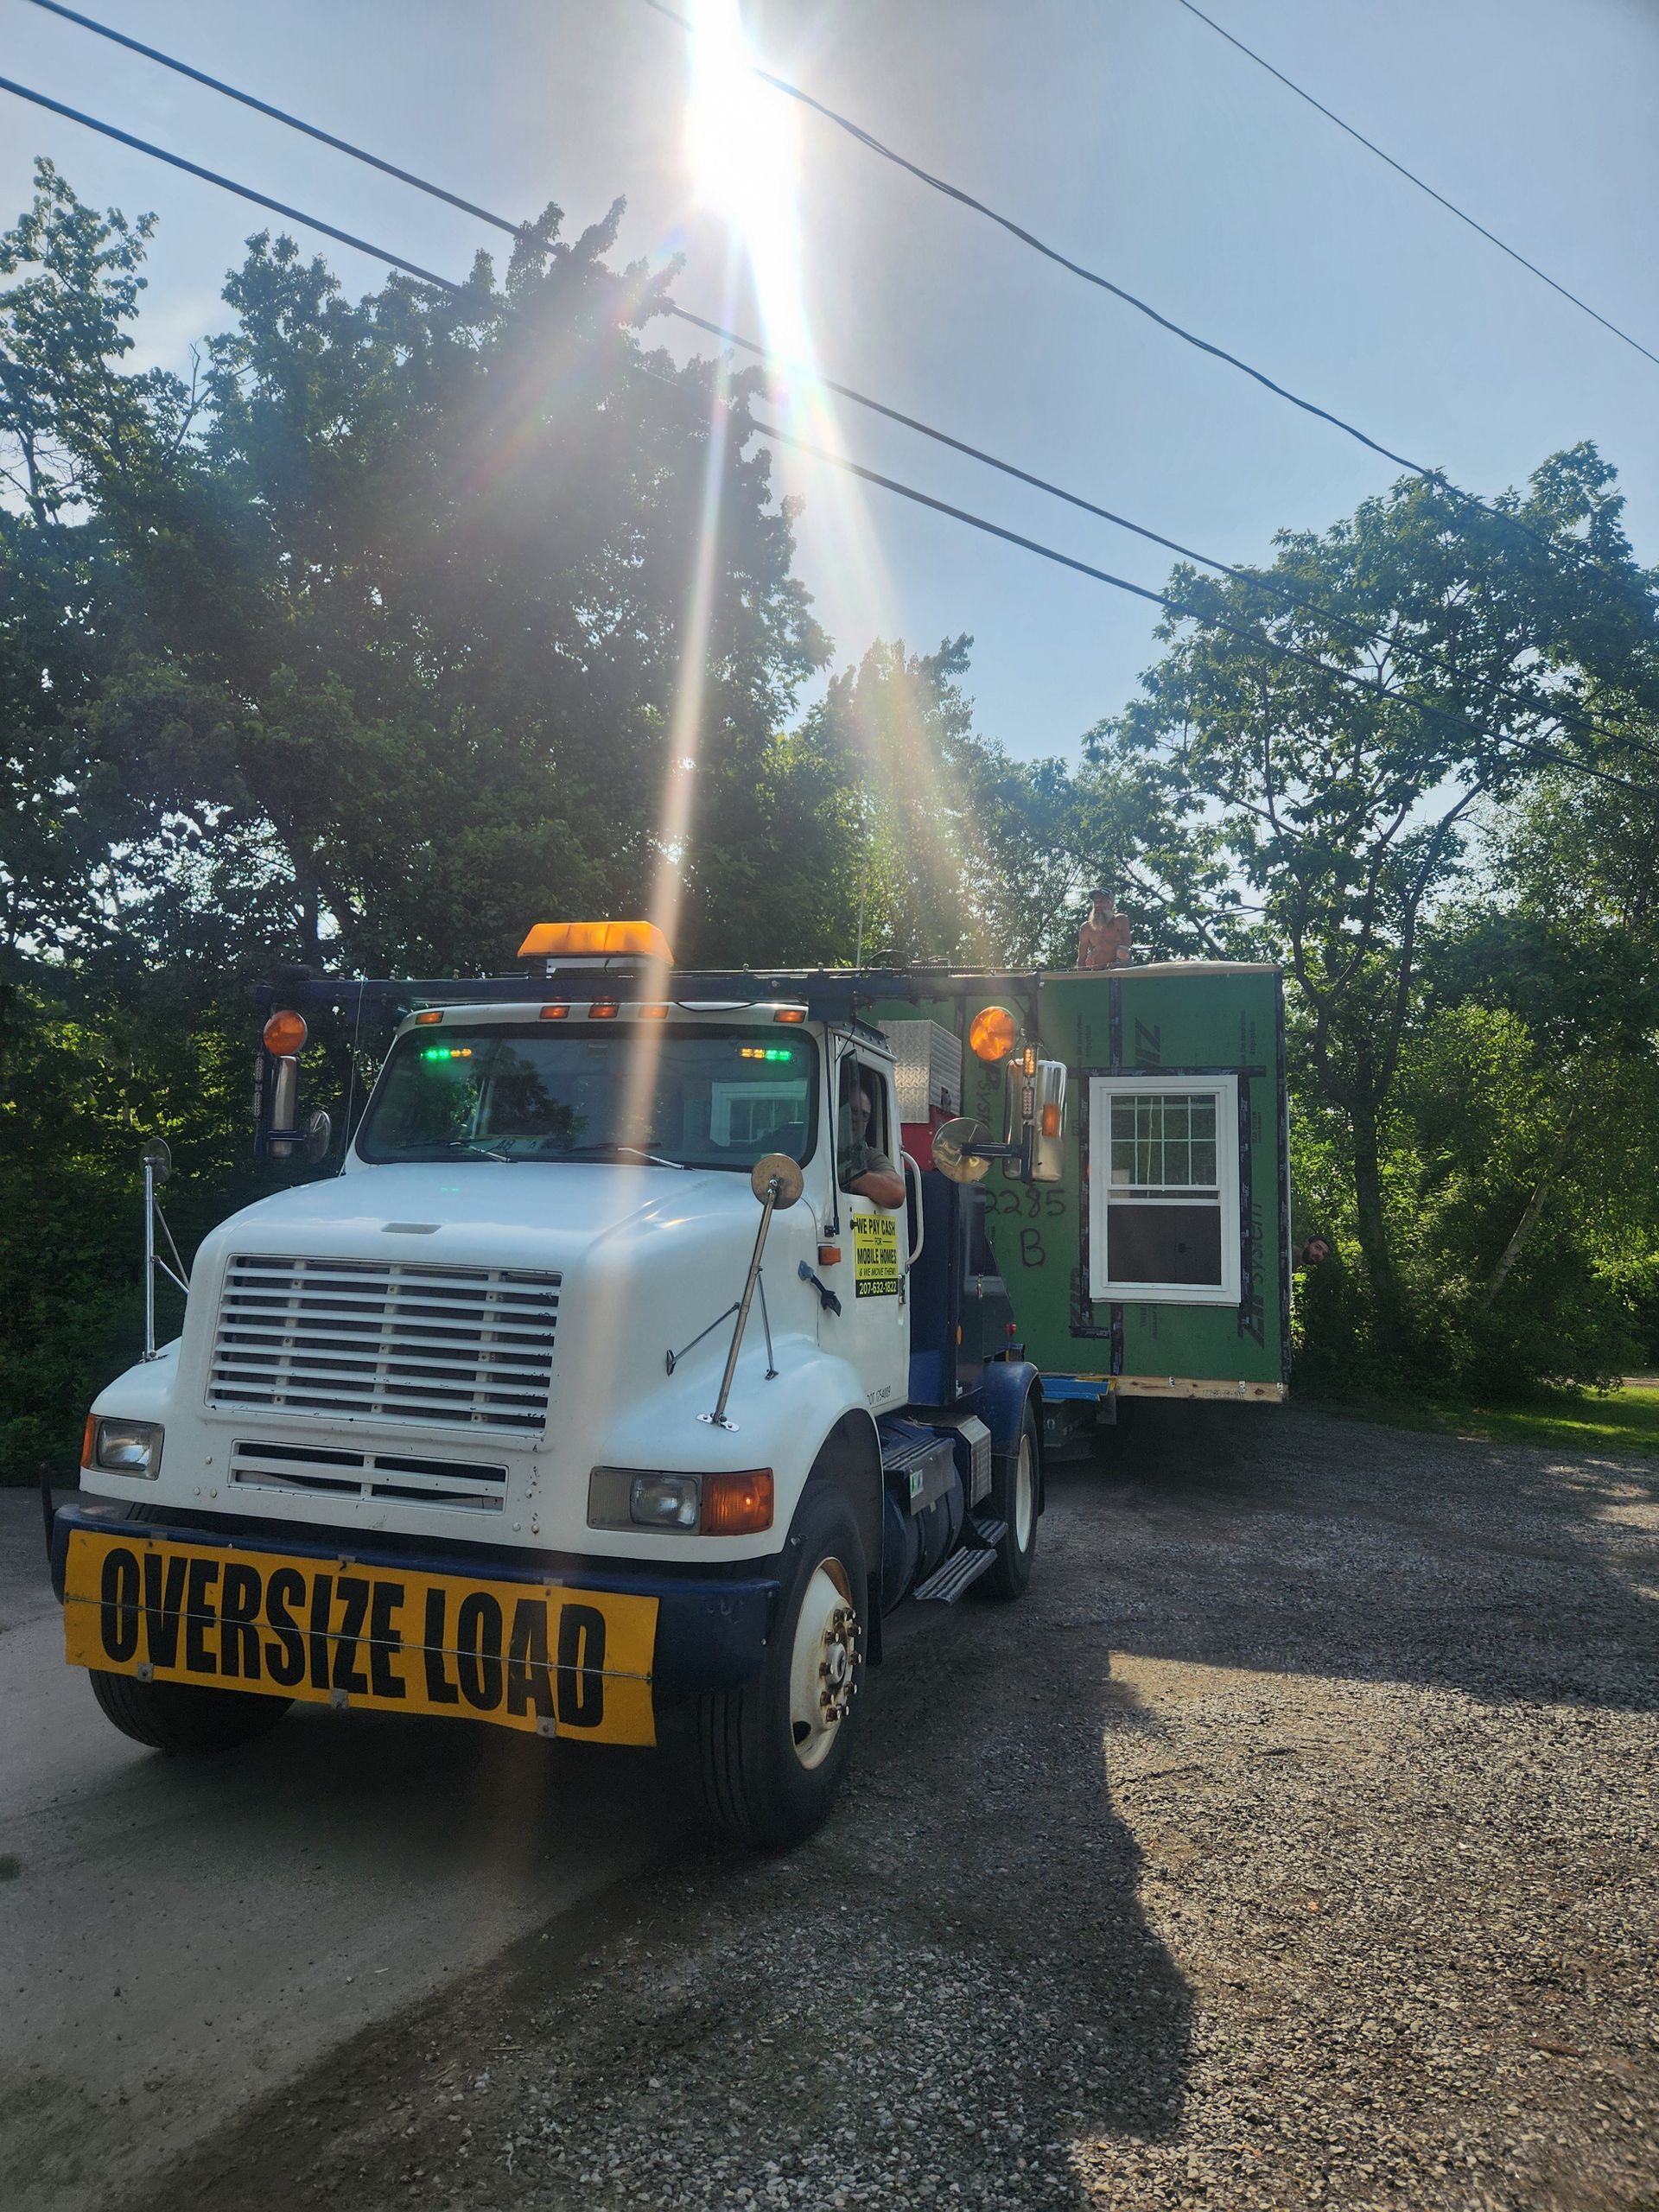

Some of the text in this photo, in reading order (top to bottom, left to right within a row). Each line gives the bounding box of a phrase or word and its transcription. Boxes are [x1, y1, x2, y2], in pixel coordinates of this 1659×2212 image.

[984, 1185, 1066, 1218] 2285
[856, 1217, 895, 1236] WE PAY CASH
[857, 1248, 896, 1264] MOBILE HOMES
[1020, 1228, 1046, 1268] B
[863, 1268, 870, 1276] WE
[871, 1268, 883, 1276] MOVE
[100, 1548, 607, 1729] OVERSIZE LOAD
